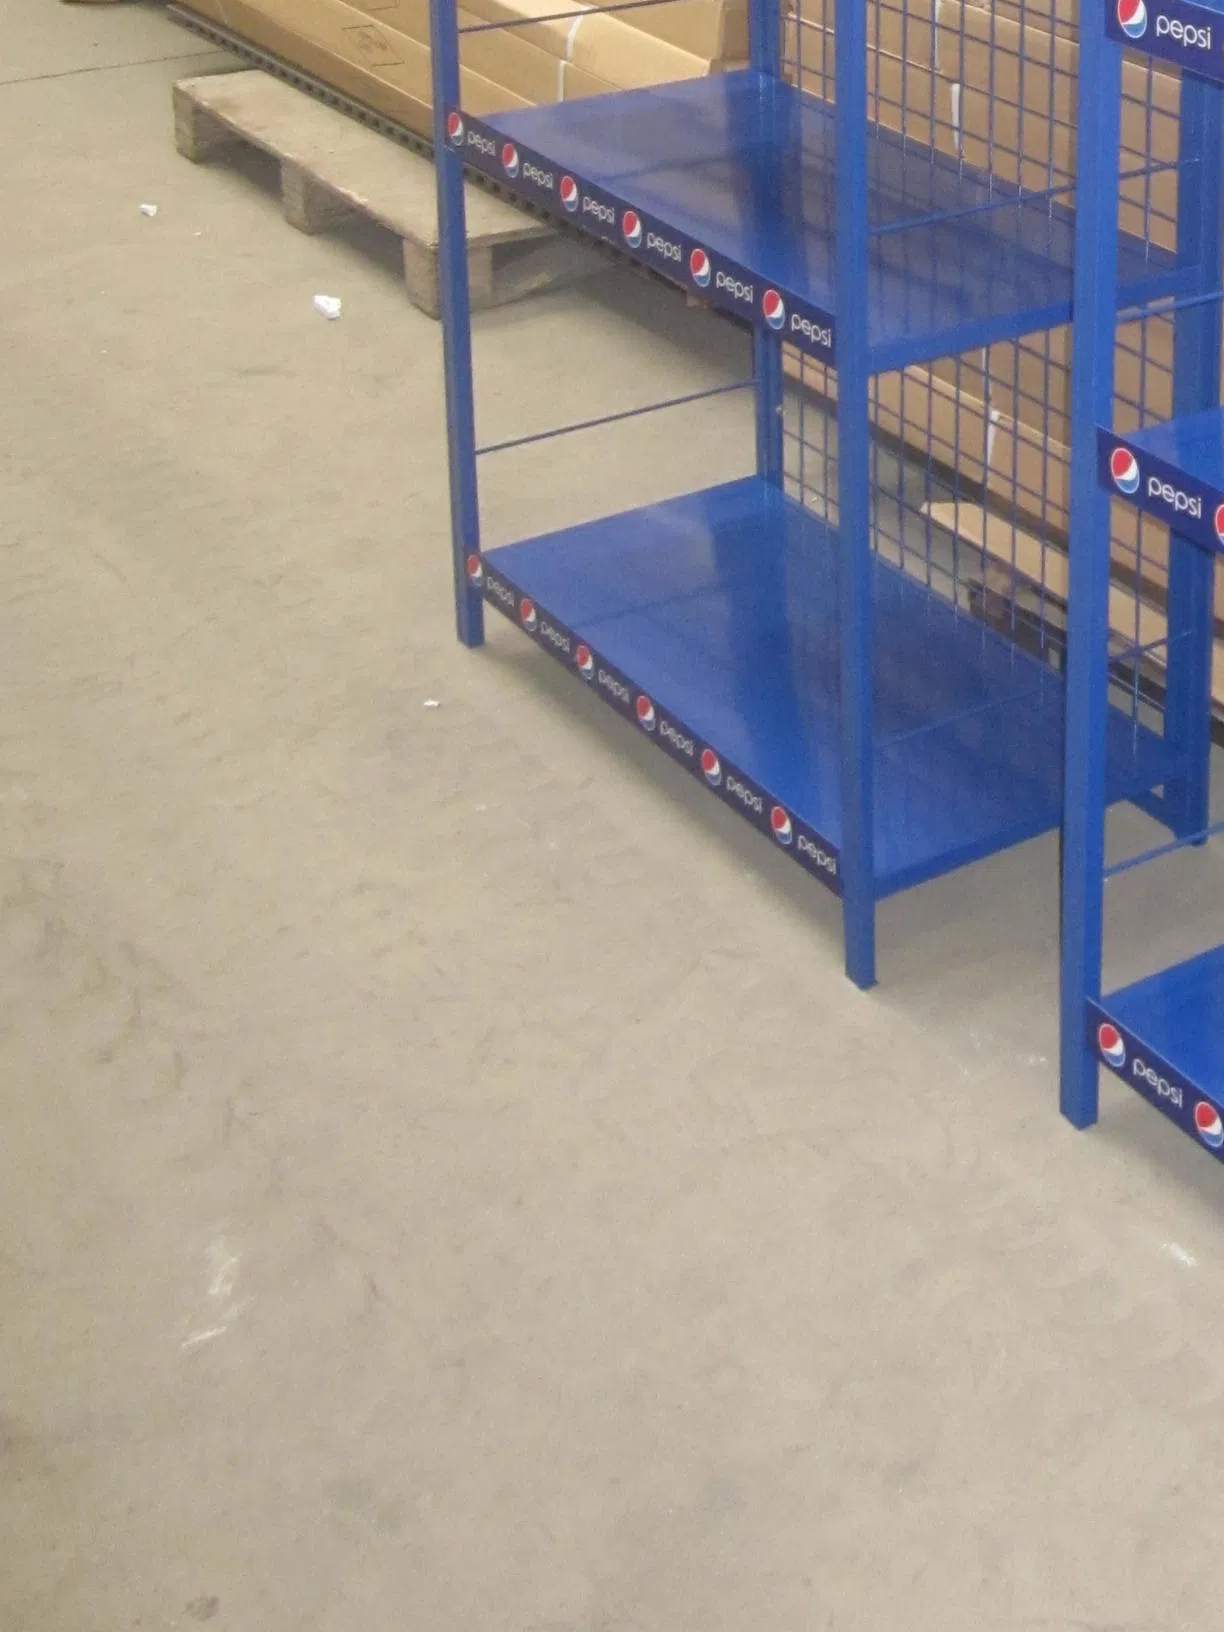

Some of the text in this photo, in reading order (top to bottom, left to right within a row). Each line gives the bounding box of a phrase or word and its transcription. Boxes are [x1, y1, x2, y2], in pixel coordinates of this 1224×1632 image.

[1155, 13, 1212, 50] pepsi
[467, 130, 833, 349] pepsi pepsi pepsi pepsi pepsi pepsi
[1147, 476, 1203, 518] pepsi
[486, 575, 838, 876] pepsi pepsi pepsi pepsi pepsi pepsi
[1132, 1058, 1184, 1108] pepsi
